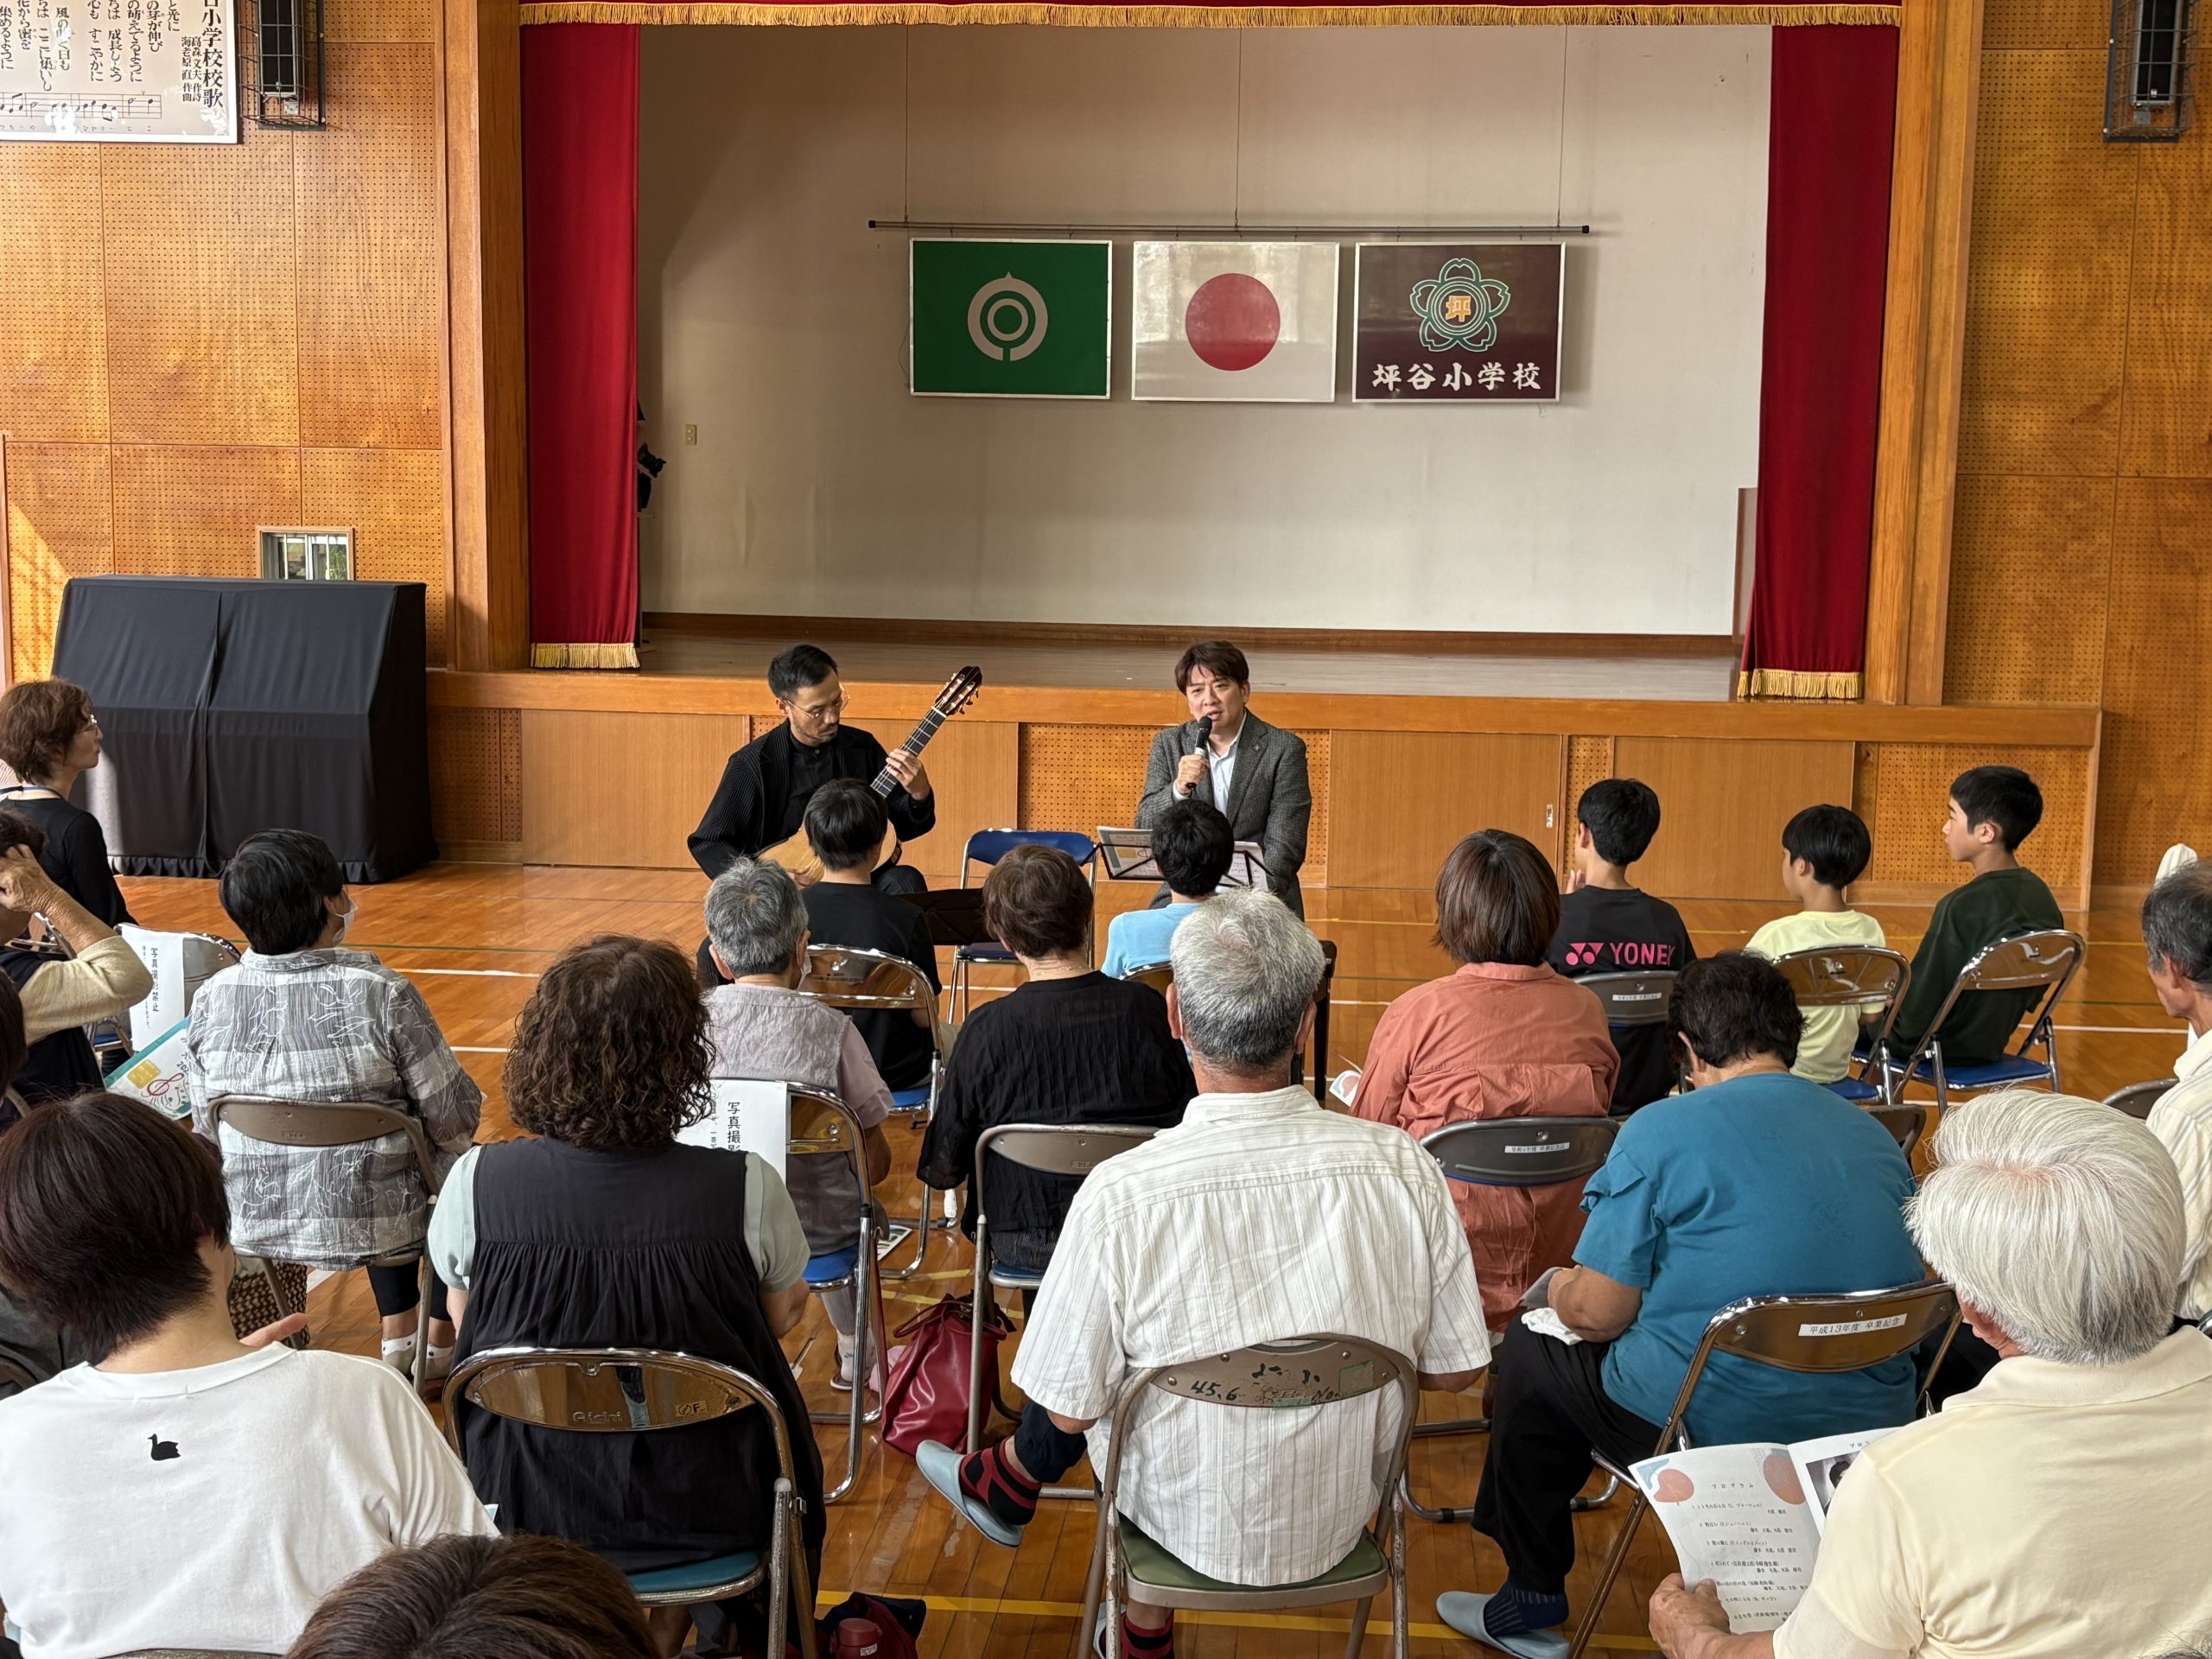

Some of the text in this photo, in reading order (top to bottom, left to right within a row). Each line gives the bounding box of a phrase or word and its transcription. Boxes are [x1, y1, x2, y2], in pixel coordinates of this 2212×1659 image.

[89, 29, 103, 81] すこやかに
[182, 83, 192, 102] 作曲
[193, 83, 202, 102] 作詩
[1445, 295, 1471, 323] 坪
[1371, 361, 1541, 392] 坪谷小学校
[1809, 1317, 1900, 1335] 平成13年度 卒業記念
